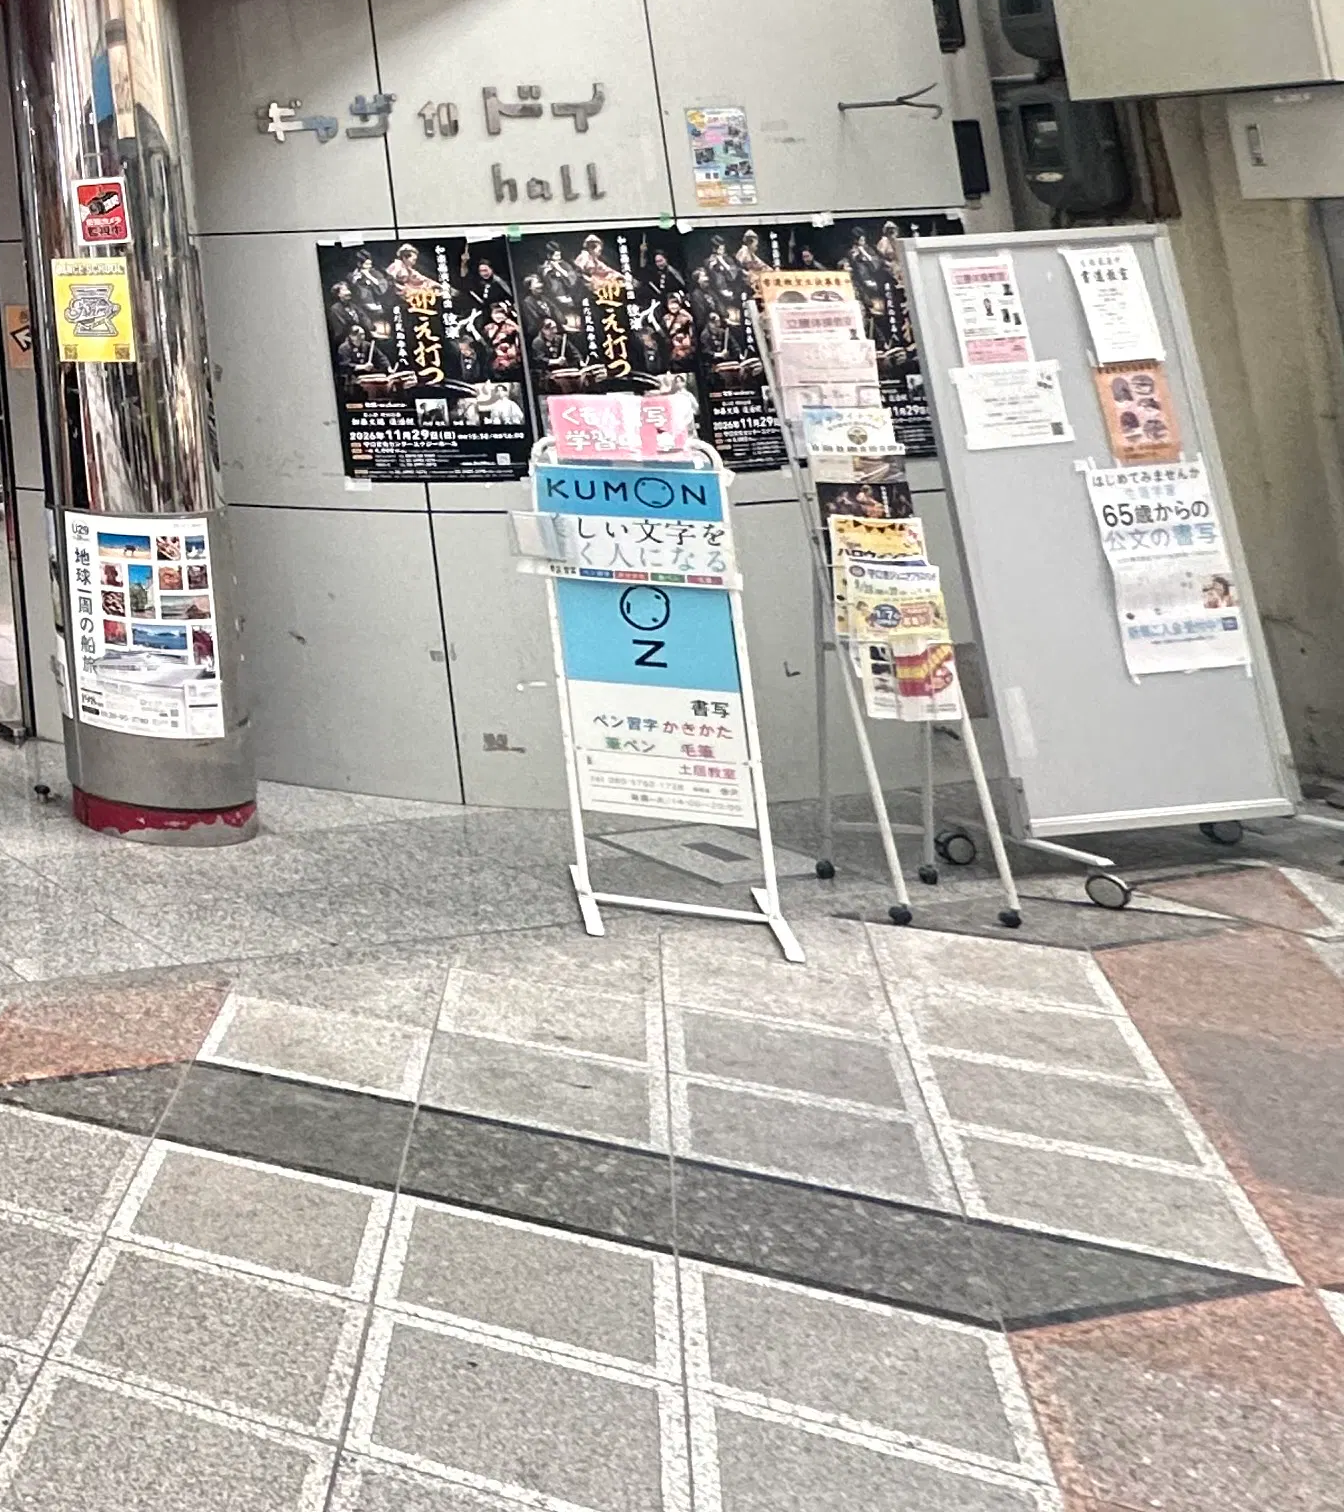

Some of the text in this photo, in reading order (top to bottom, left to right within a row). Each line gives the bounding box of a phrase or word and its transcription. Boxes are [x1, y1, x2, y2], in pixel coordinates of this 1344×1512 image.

[491, 162, 606, 203] hall
[1092, 468, 1200, 488] はじめてみませんか
[545, 476, 709, 509] KUMON
[1102, 500, 1210, 528] 65歳からの
[74, 545, 97, 677] 地球一周の船旅
[690, 699, 730, 719] 書写
[593, 714, 734, 740] ペン習字 かきかた
